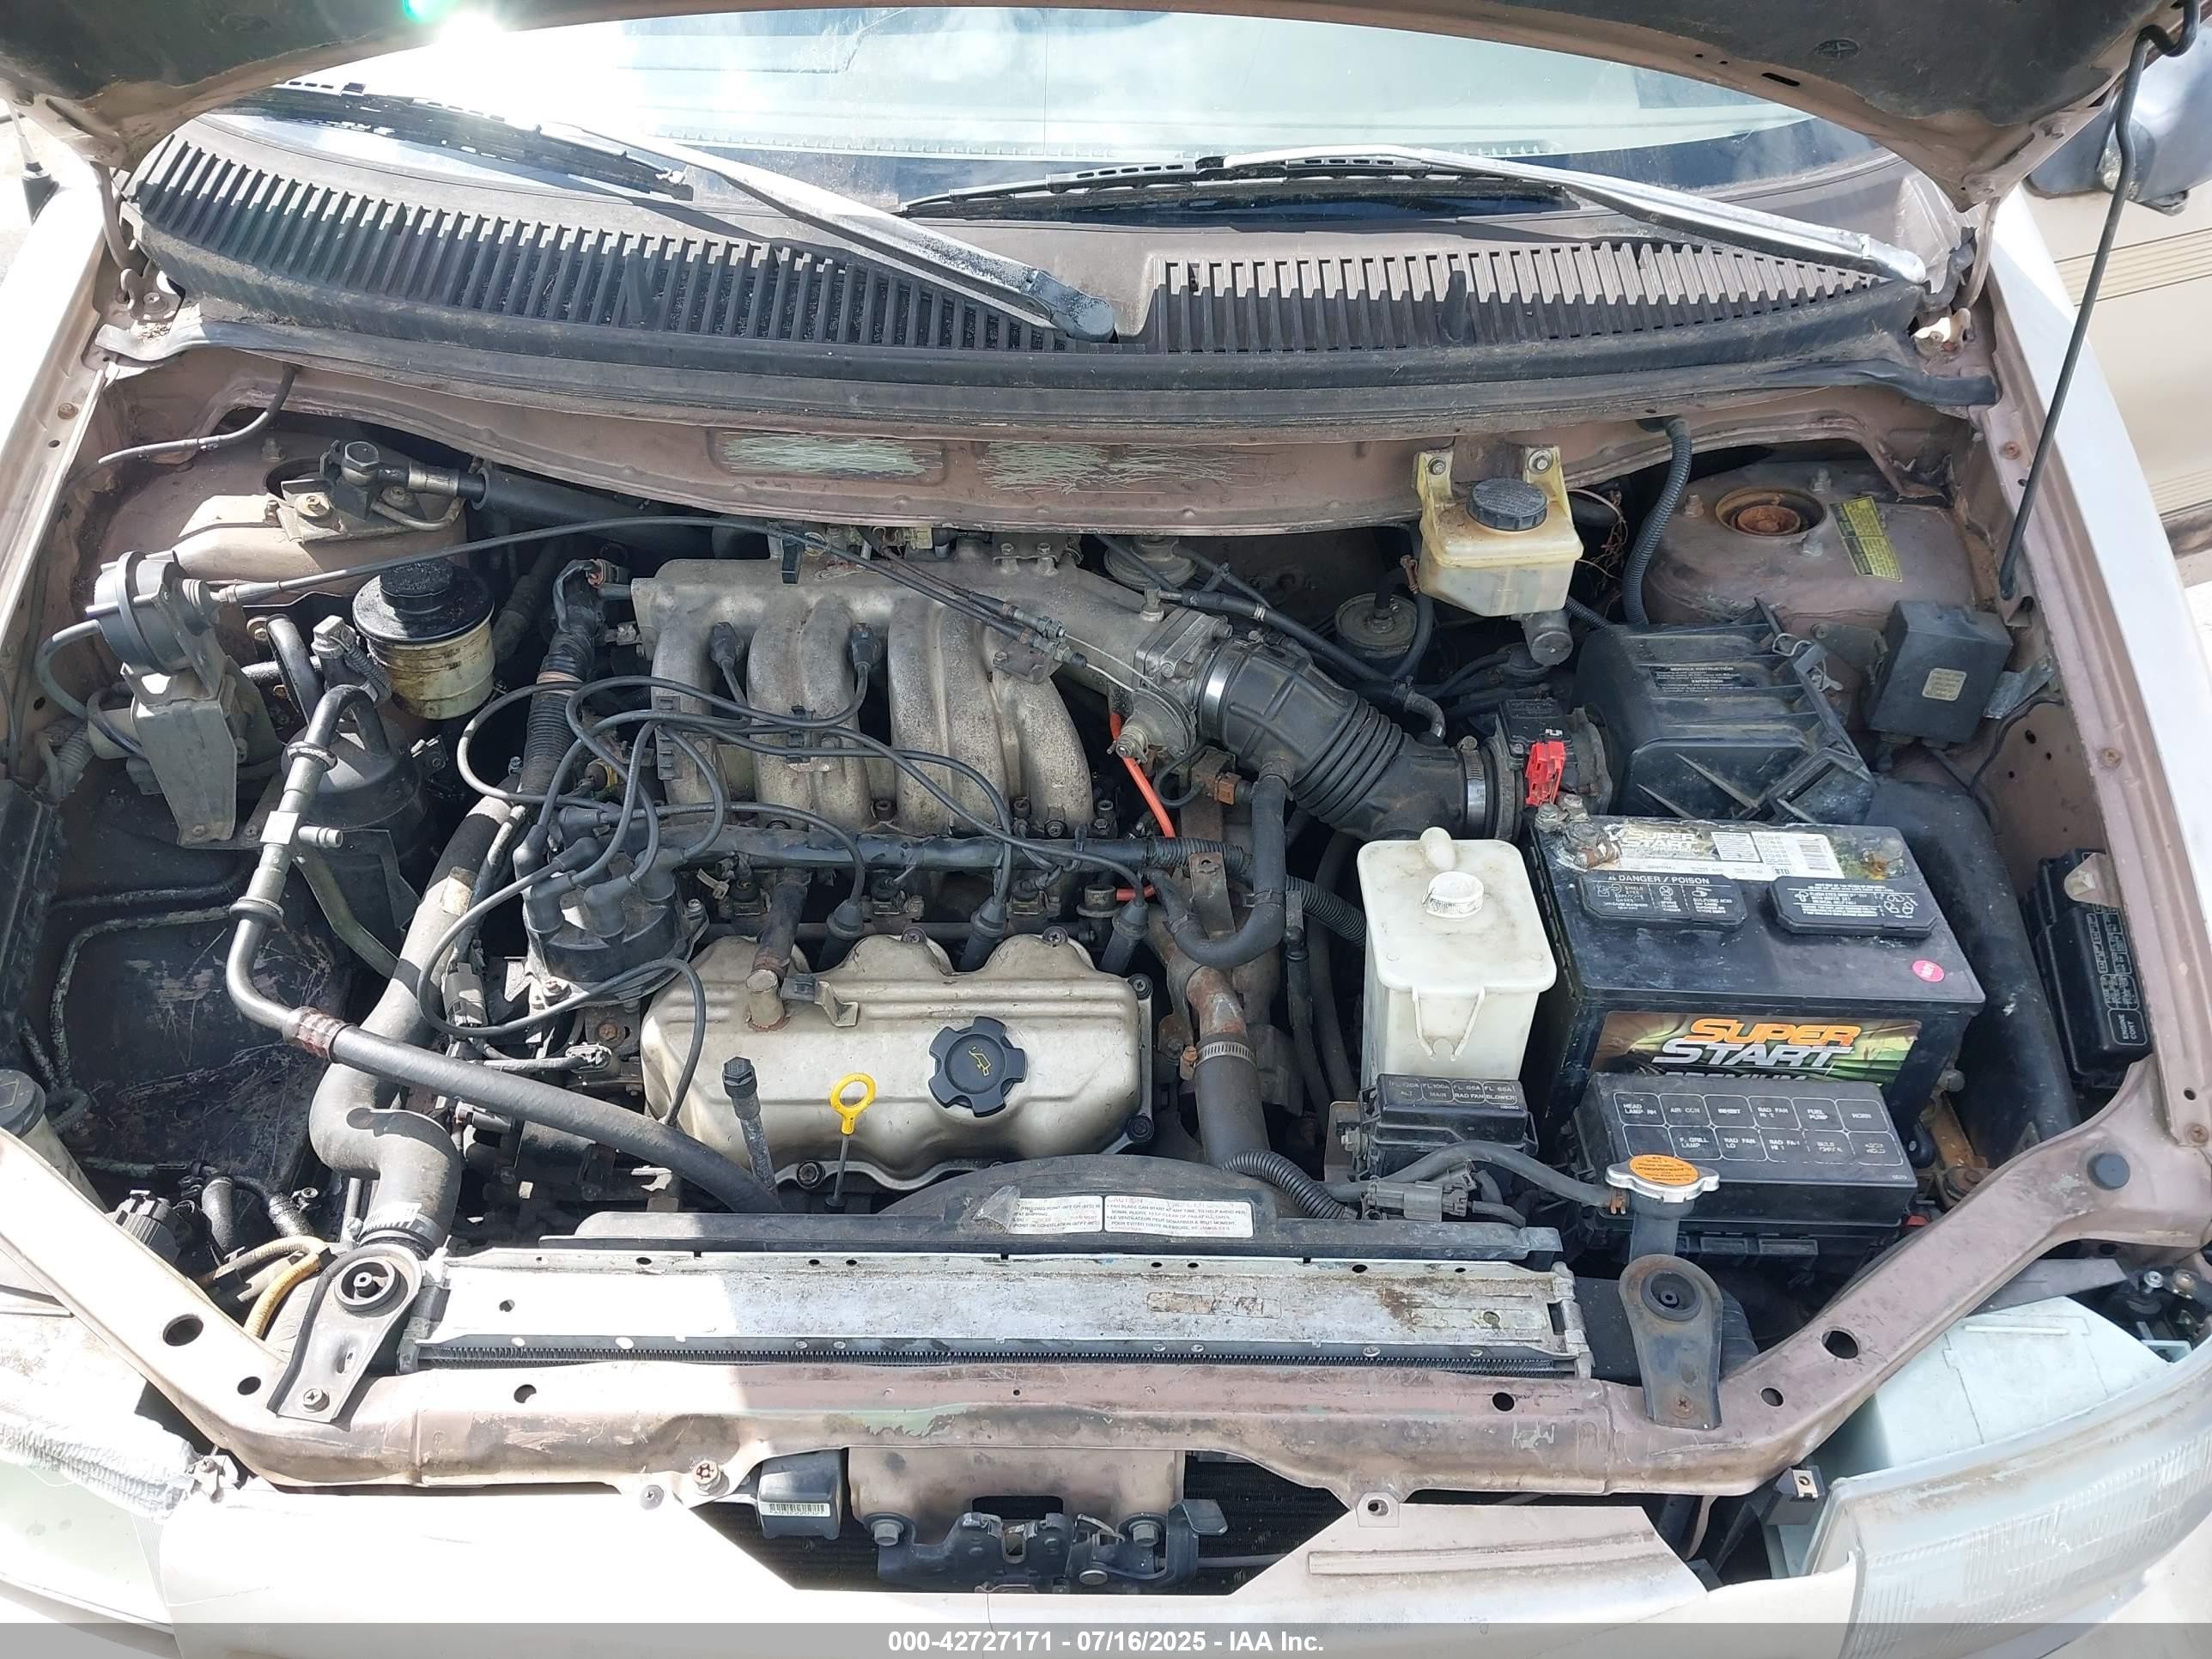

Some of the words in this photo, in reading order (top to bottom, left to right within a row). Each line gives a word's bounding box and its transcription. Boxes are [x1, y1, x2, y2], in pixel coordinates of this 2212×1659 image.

[1619, 874, 1661, 883] DANGER
[1683, 1018, 1862, 1046] SUPER
[2118, 1014, 2130, 1040] ENGINE
[2127, 1021, 2136, 1040] CONT
[1651, 1038, 1855, 1068] START
